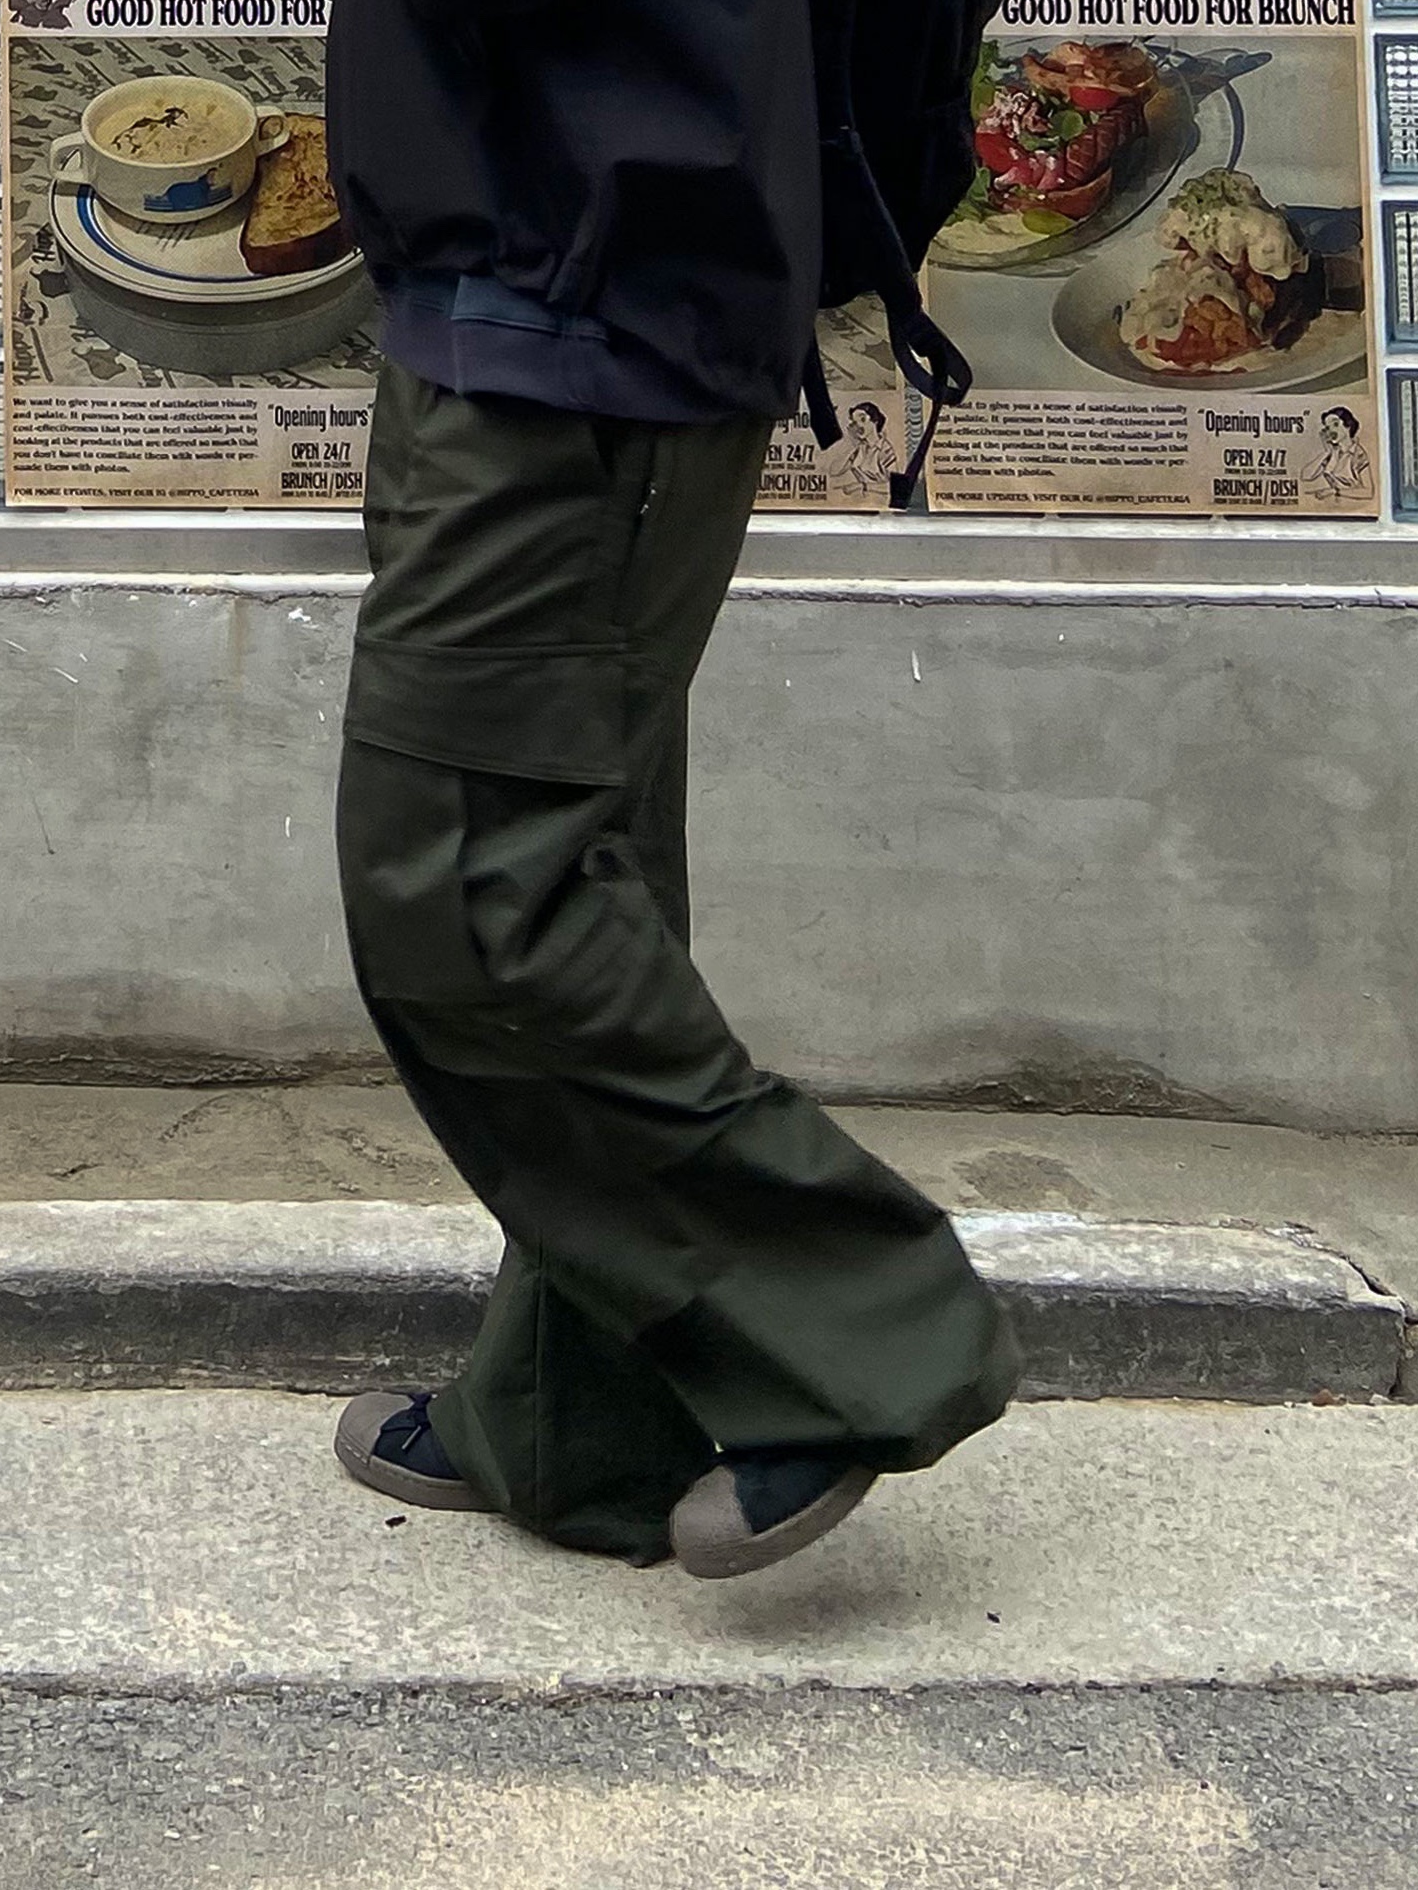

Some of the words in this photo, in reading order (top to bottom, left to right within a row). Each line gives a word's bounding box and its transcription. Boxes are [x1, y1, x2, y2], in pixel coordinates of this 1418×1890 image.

[292, 443, 318, 459] OPEN
[324, 442, 350, 460] 24/7
[787, 445, 814, 463] 24/7
[1224, 449, 1253, 466] OPEN
[1258, 450, 1287, 467] 24/7
